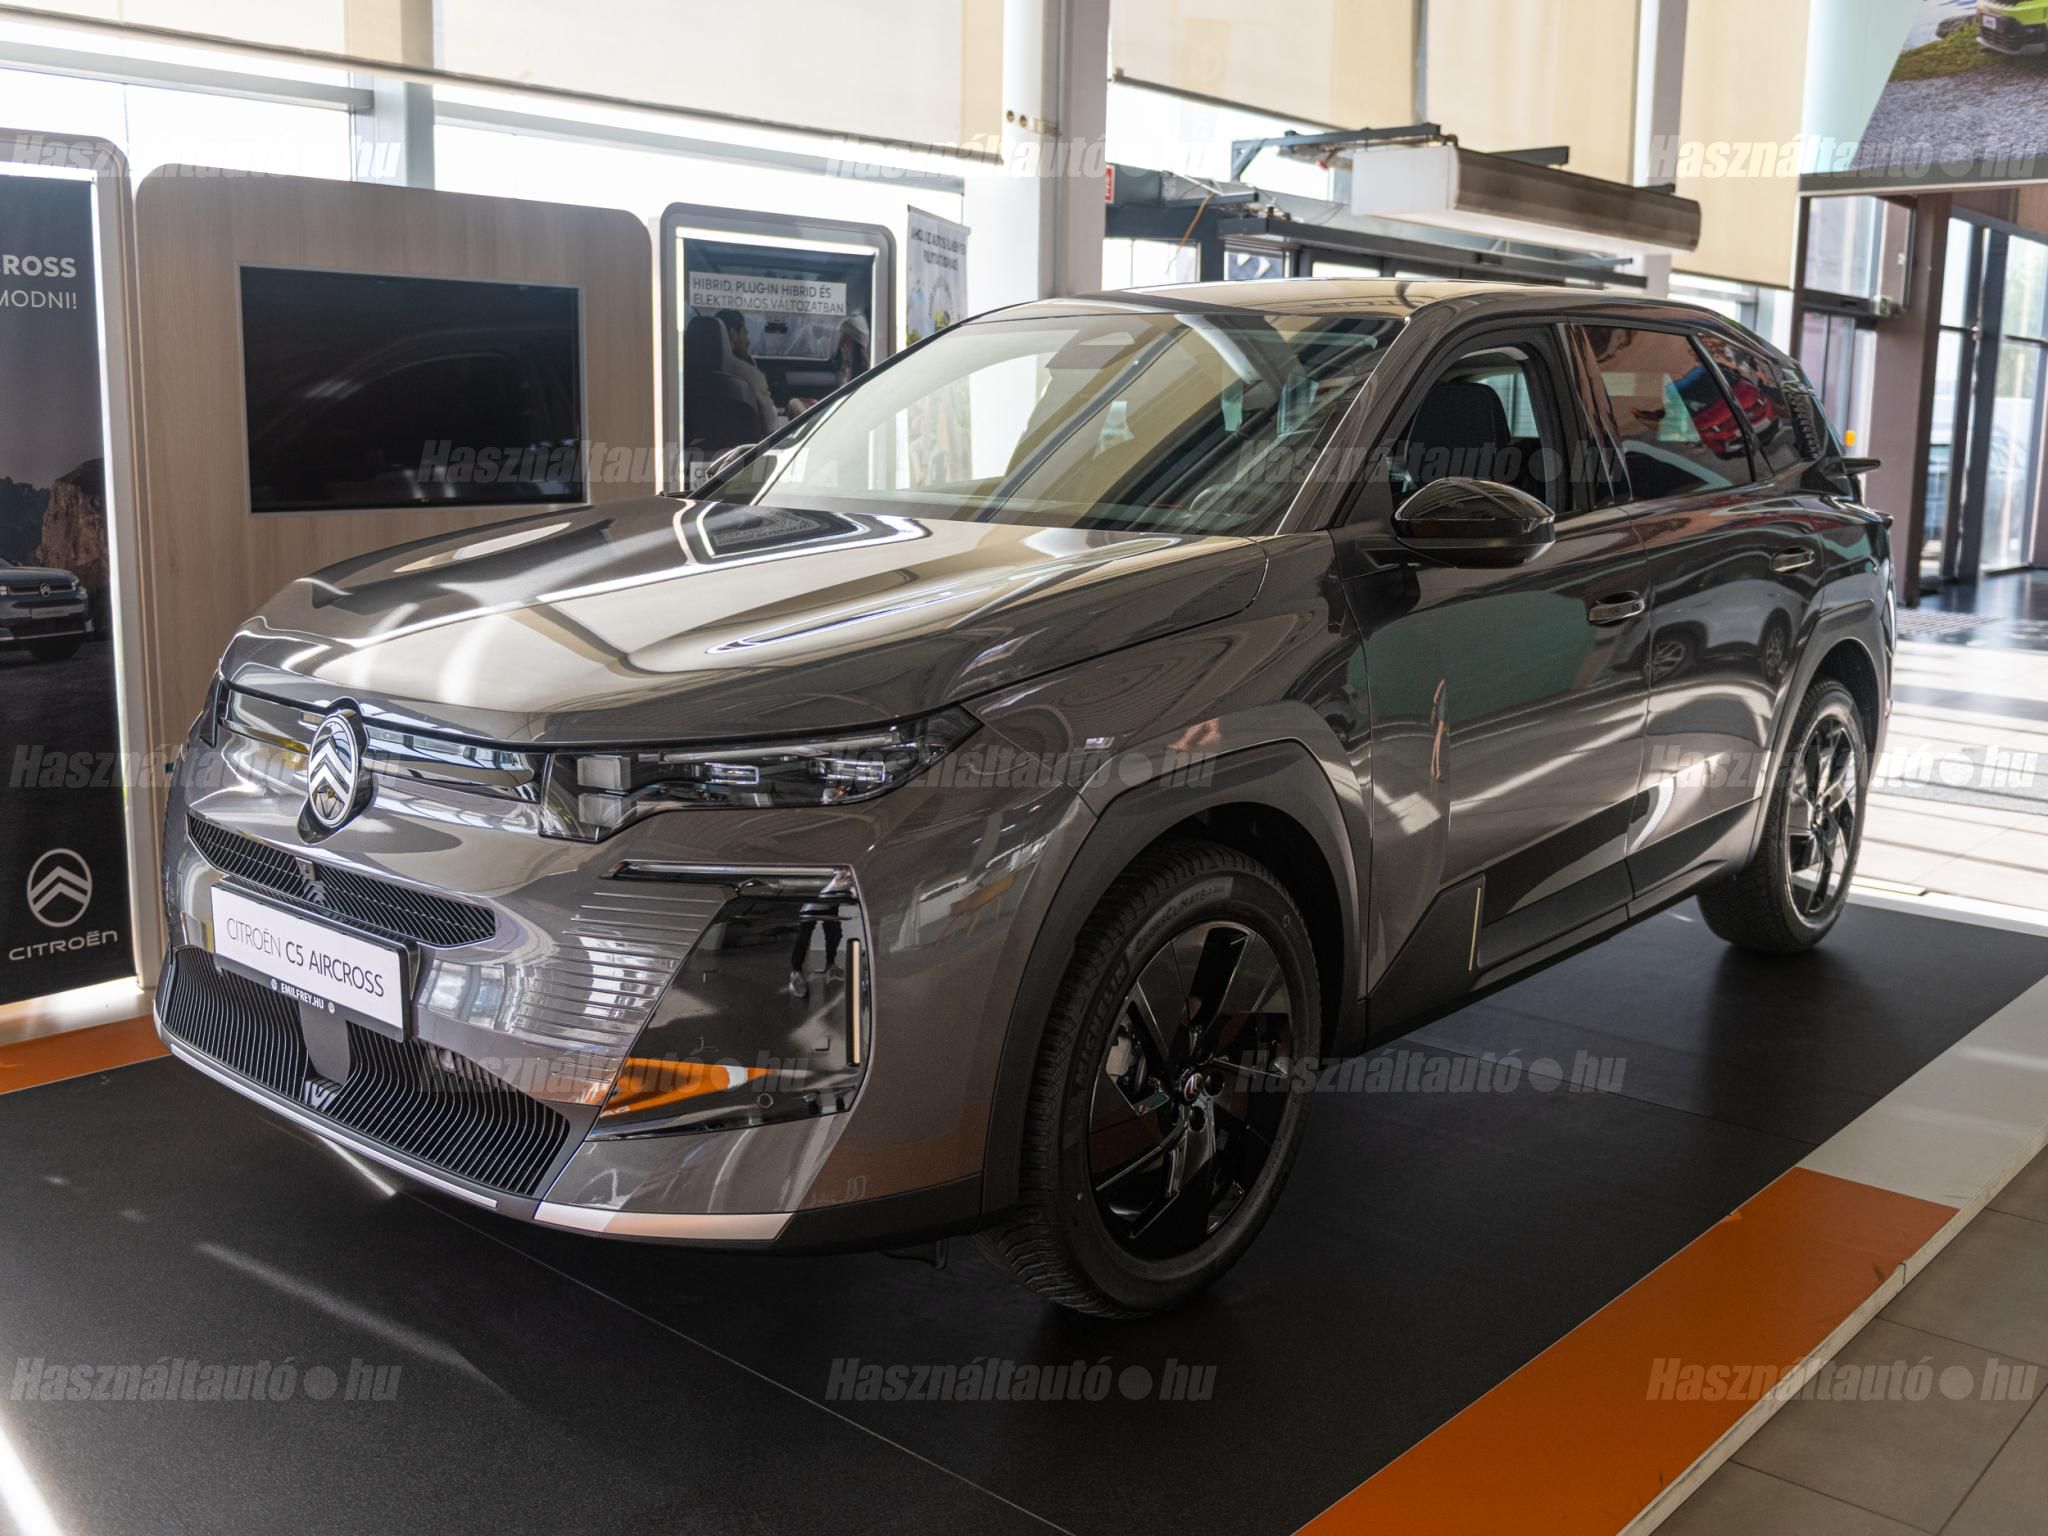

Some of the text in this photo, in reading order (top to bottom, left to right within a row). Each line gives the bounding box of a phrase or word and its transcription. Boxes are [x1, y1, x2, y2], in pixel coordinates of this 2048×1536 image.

[0, 254, 77, 278] ROSS
[693, 278, 832, 299] HIBRID, PLUG-IN HIBRID ÉS
[693, 294, 844, 314] ELEKTROMOS VÁLTOZATBAN
[227, 918, 385, 998] CITROËN C5 AIRCROSS
[281, 982, 324, 1009] EMILFREY.HU
